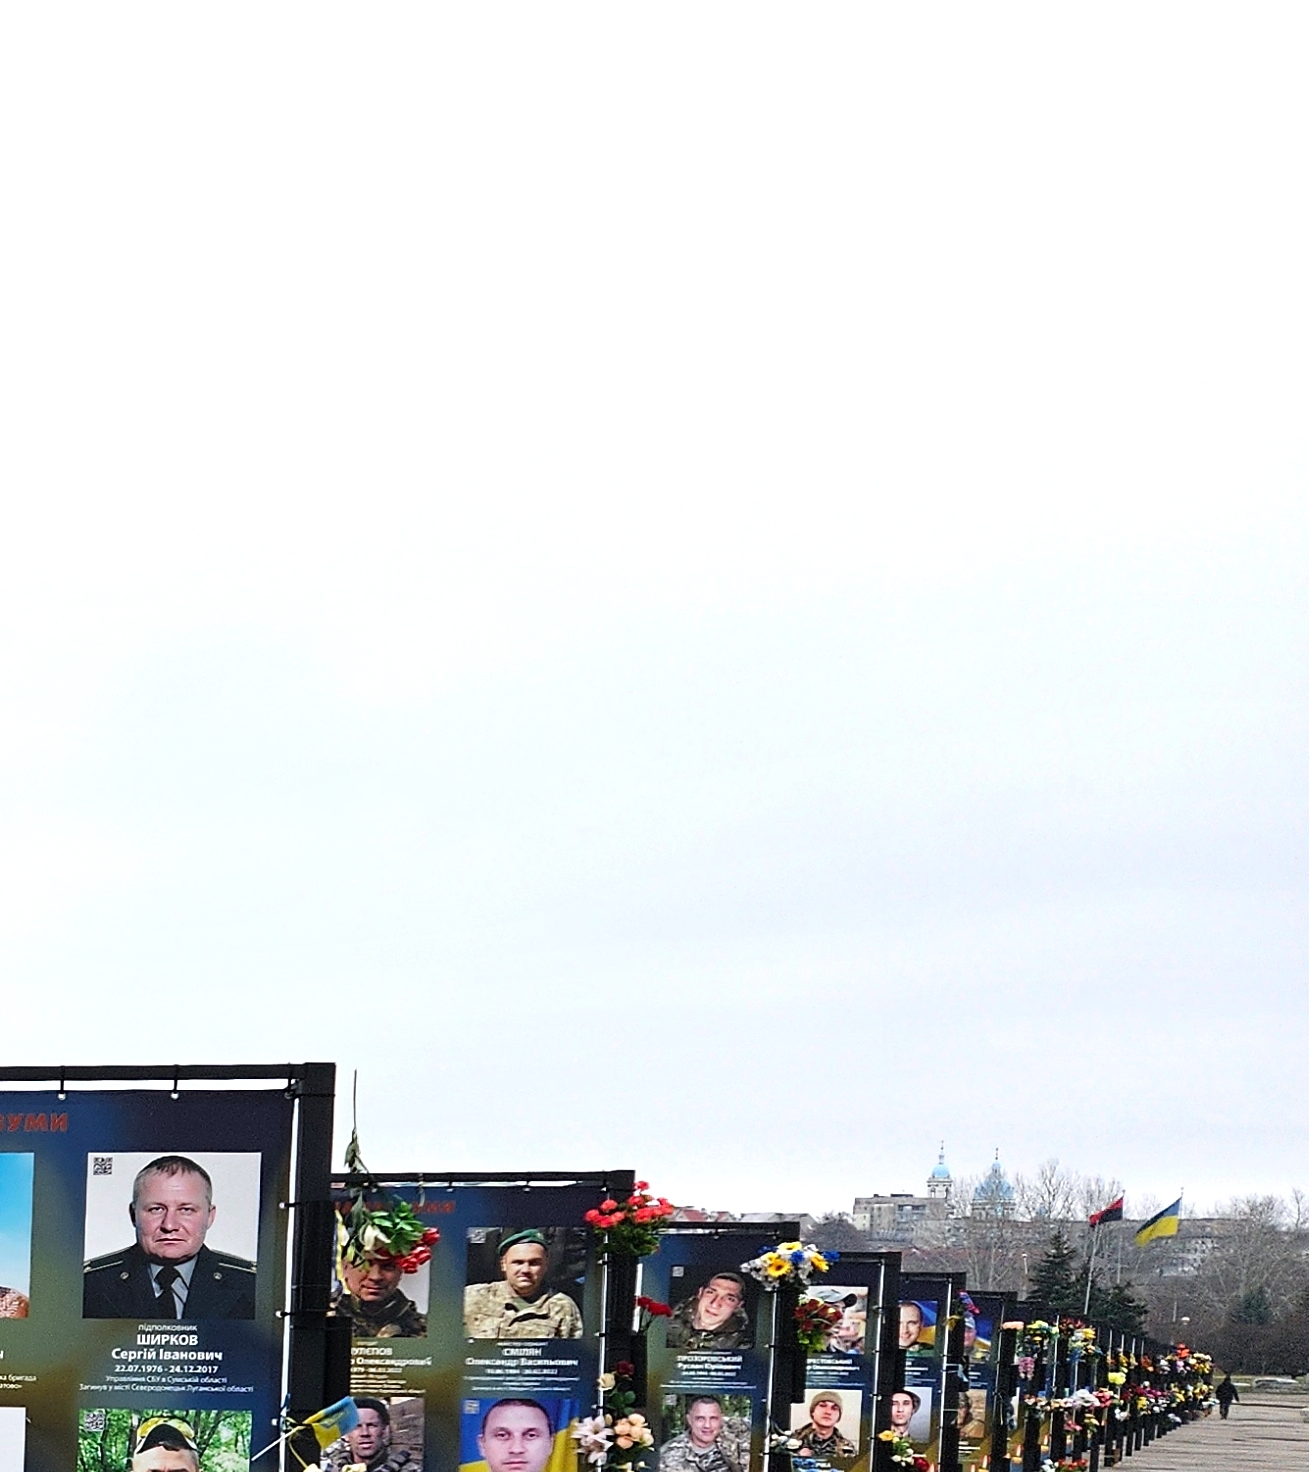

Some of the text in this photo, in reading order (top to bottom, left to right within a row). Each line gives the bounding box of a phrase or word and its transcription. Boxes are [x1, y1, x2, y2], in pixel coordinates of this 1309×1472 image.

[136, 1334, 198, 1345] ШИРКОВ
[111, 1347, 223, 1362] Сергій Іванович
